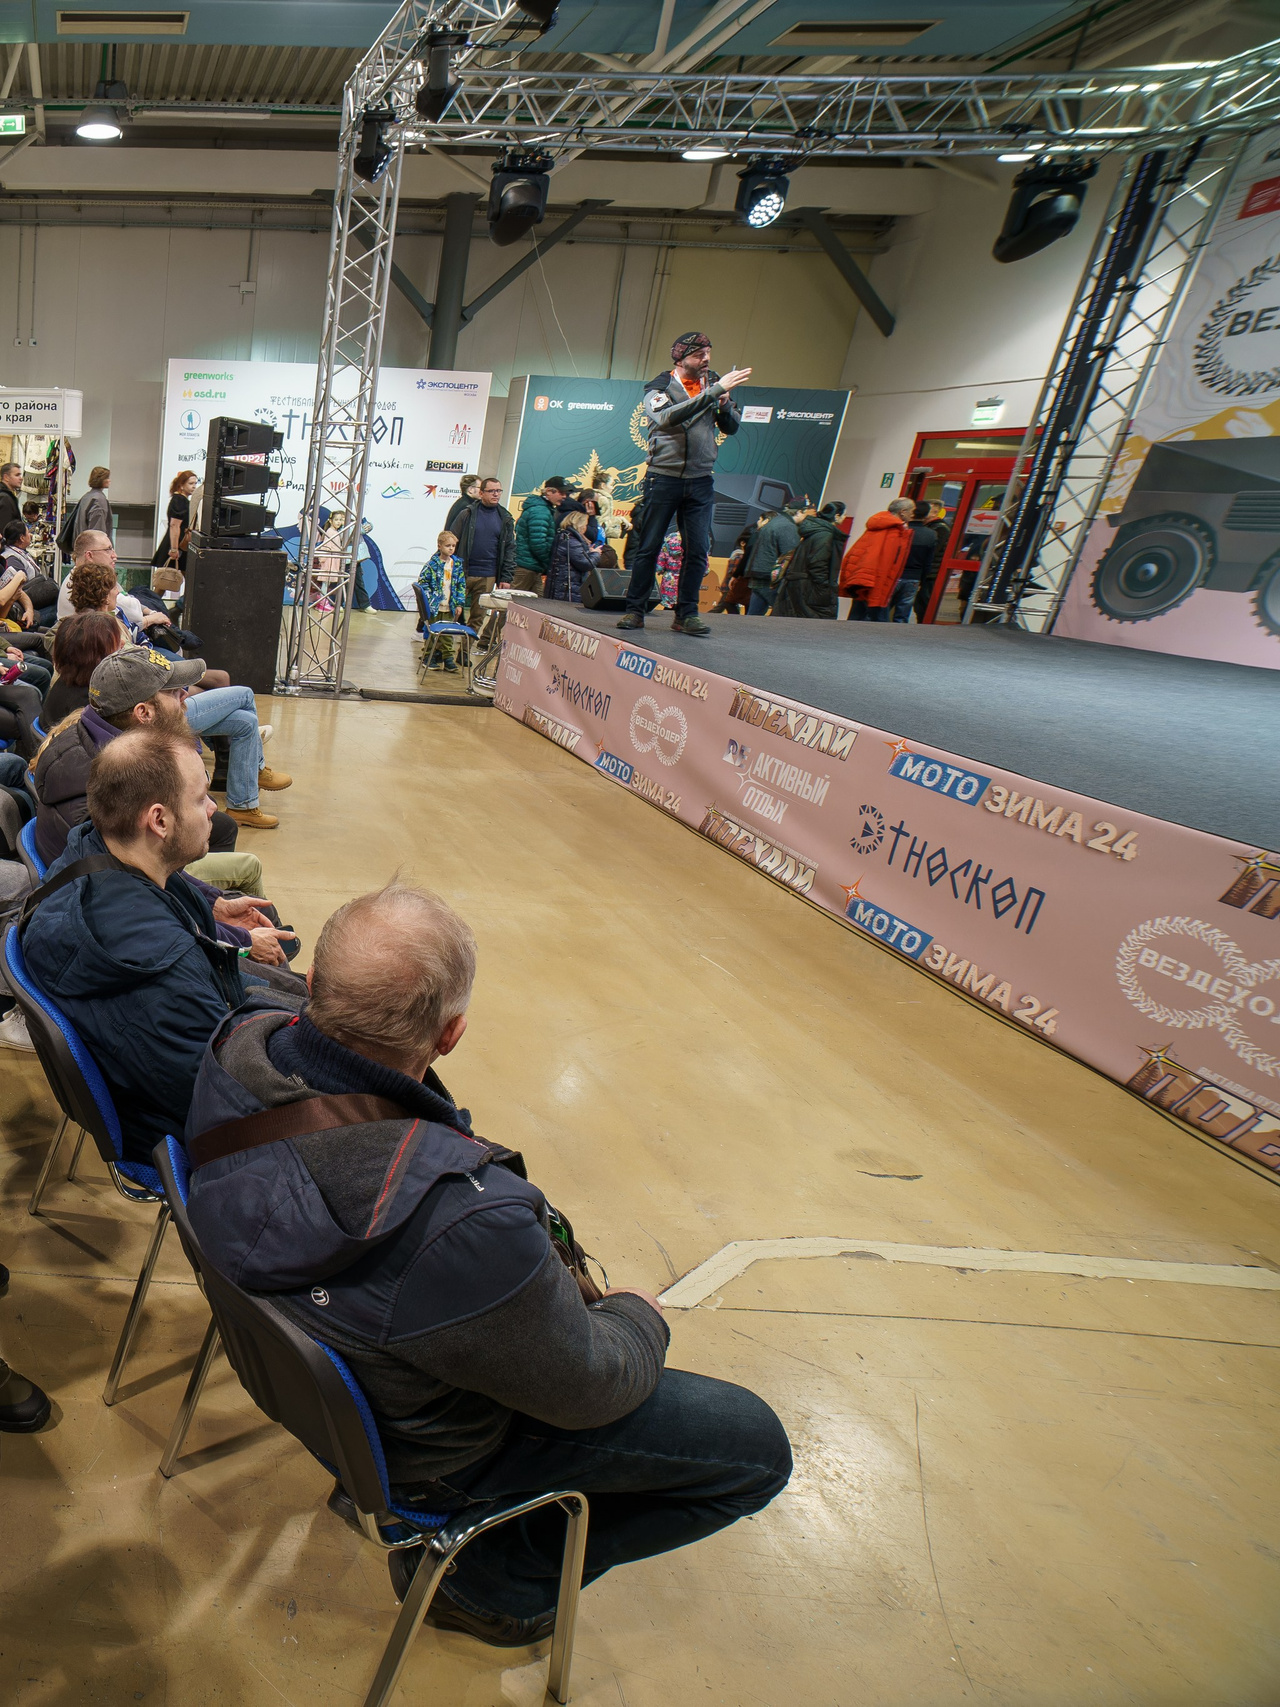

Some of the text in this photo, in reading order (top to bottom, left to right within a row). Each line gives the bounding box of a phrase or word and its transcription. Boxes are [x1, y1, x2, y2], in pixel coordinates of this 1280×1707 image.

[1224, 306, 1280, 338] ВЕ
[184, 372, 234, 381] greenworks
[428, 382, 478, 390] ЭКСПОЦЕНТР
[14, 399, 58, 412] района
[194, 389, 226, 399] osd.ru
[567, 401, 614, 411] greenworks
[5, 412, 33, 423] края
[787, 411, 834, 419] ЭКСПОЦЕНТР
[269, 456, 297, 464] NEWS
[426, 460, 464, 471] Версия
[519, 614, 529, 630] 24
[539, 619, 600, 660] ПОЕХАЛИ
[620, 654, 709, 701] МОТО ЗИМА 24
[635, 714, 681, 744] ВЕЗДЕХОДЕР
[728, 689, 859, 761] ПОЕХАЛИ
[599, 753, 682, 813] МОТО ЗИМА 24
[752, 752, 830, 807] АКТИВНЫЙ
[742, 786, 789, 824] ОТДЫХ
[899, 756, 1139, 861] МОТО ЗИМА 24
[699, 811, 817, 895] ПОЕХАЛИ
[853, 902, 1060, 1036] МОТО ЗИМА 24
[1138, 947, 1280, 1026] ВЕЗДЕХО
